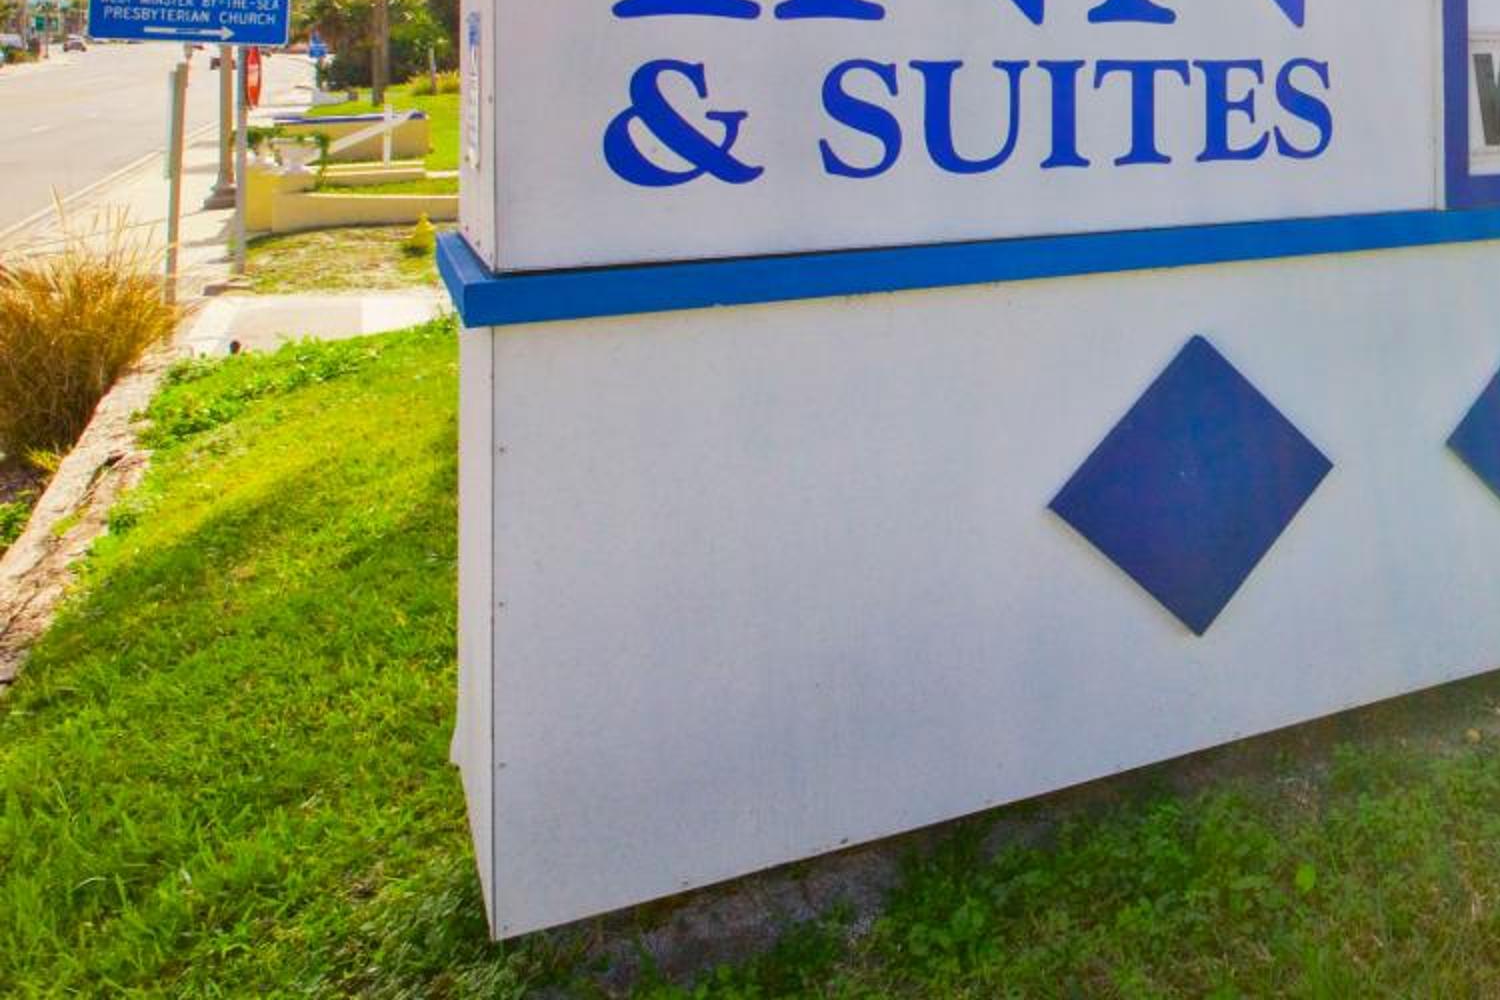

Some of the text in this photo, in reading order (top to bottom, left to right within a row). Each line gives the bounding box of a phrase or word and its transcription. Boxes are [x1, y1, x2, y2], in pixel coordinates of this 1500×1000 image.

[103, 6, 276, 25] PRESBYTERIAN CHURCH
[603, 57, 1333, 187] & SUITES
